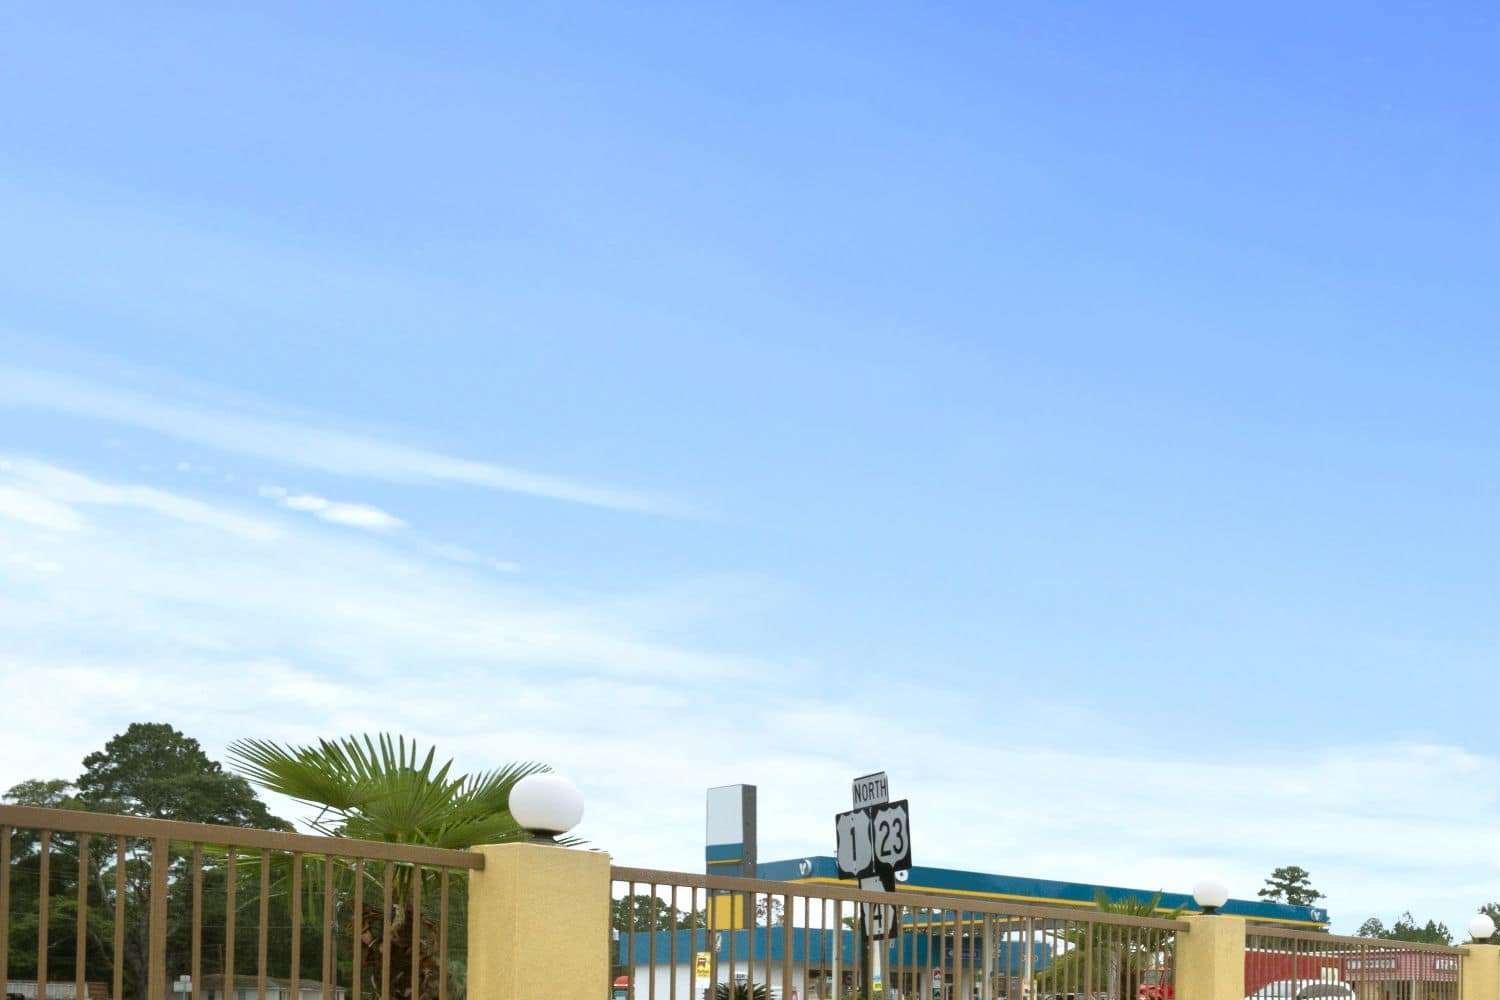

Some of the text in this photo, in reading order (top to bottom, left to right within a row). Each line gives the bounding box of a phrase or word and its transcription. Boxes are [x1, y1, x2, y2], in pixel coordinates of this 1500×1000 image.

[853, 778, 888, 803] NORTH
[850, 826, 857, 861] 1
[879, 818, 904, 857] 23
